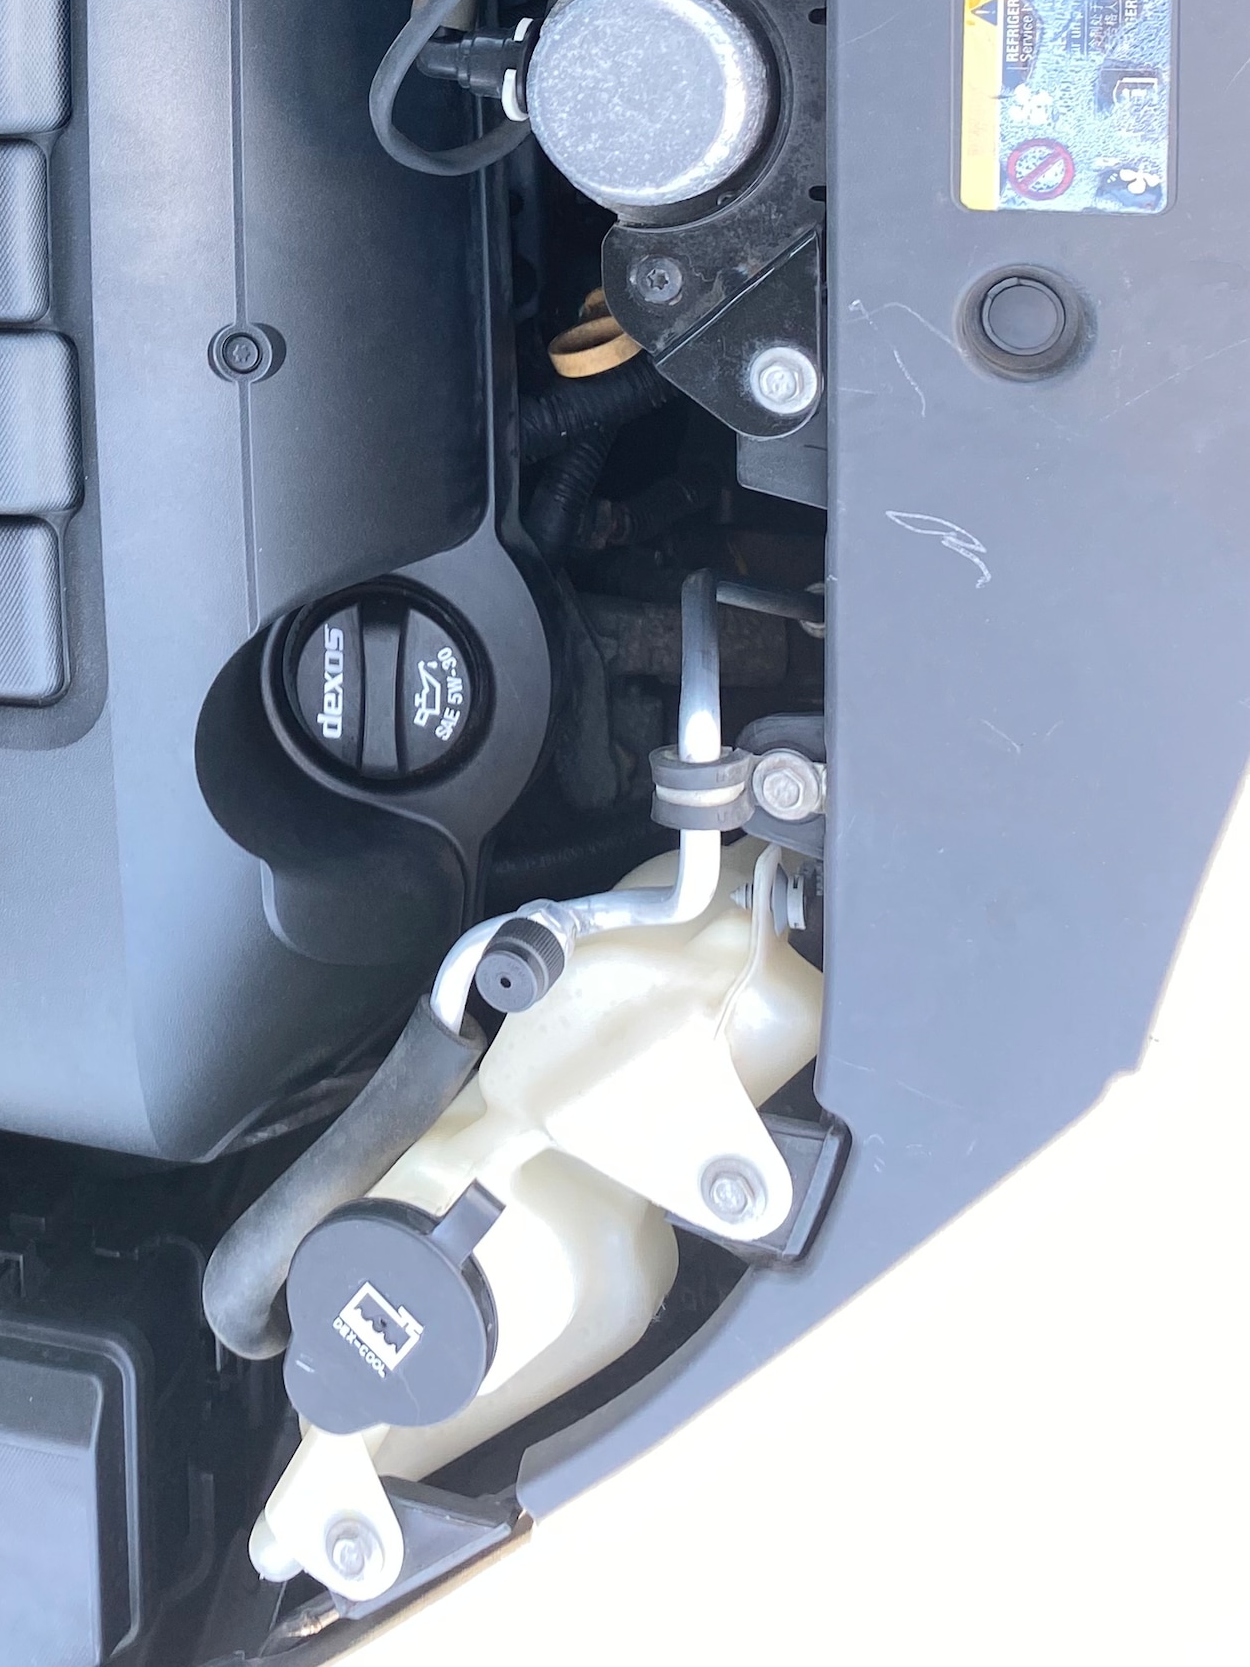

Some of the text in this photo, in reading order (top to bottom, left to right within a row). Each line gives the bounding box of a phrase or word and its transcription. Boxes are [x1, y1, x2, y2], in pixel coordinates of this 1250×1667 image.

[1020, 15, 1034, 62] Service
[317, 626, 344, 739] dexos
[435, 647, 463, 741] SAE 5W-30
[332, 1315, 387, 1379] DEX-COOL
